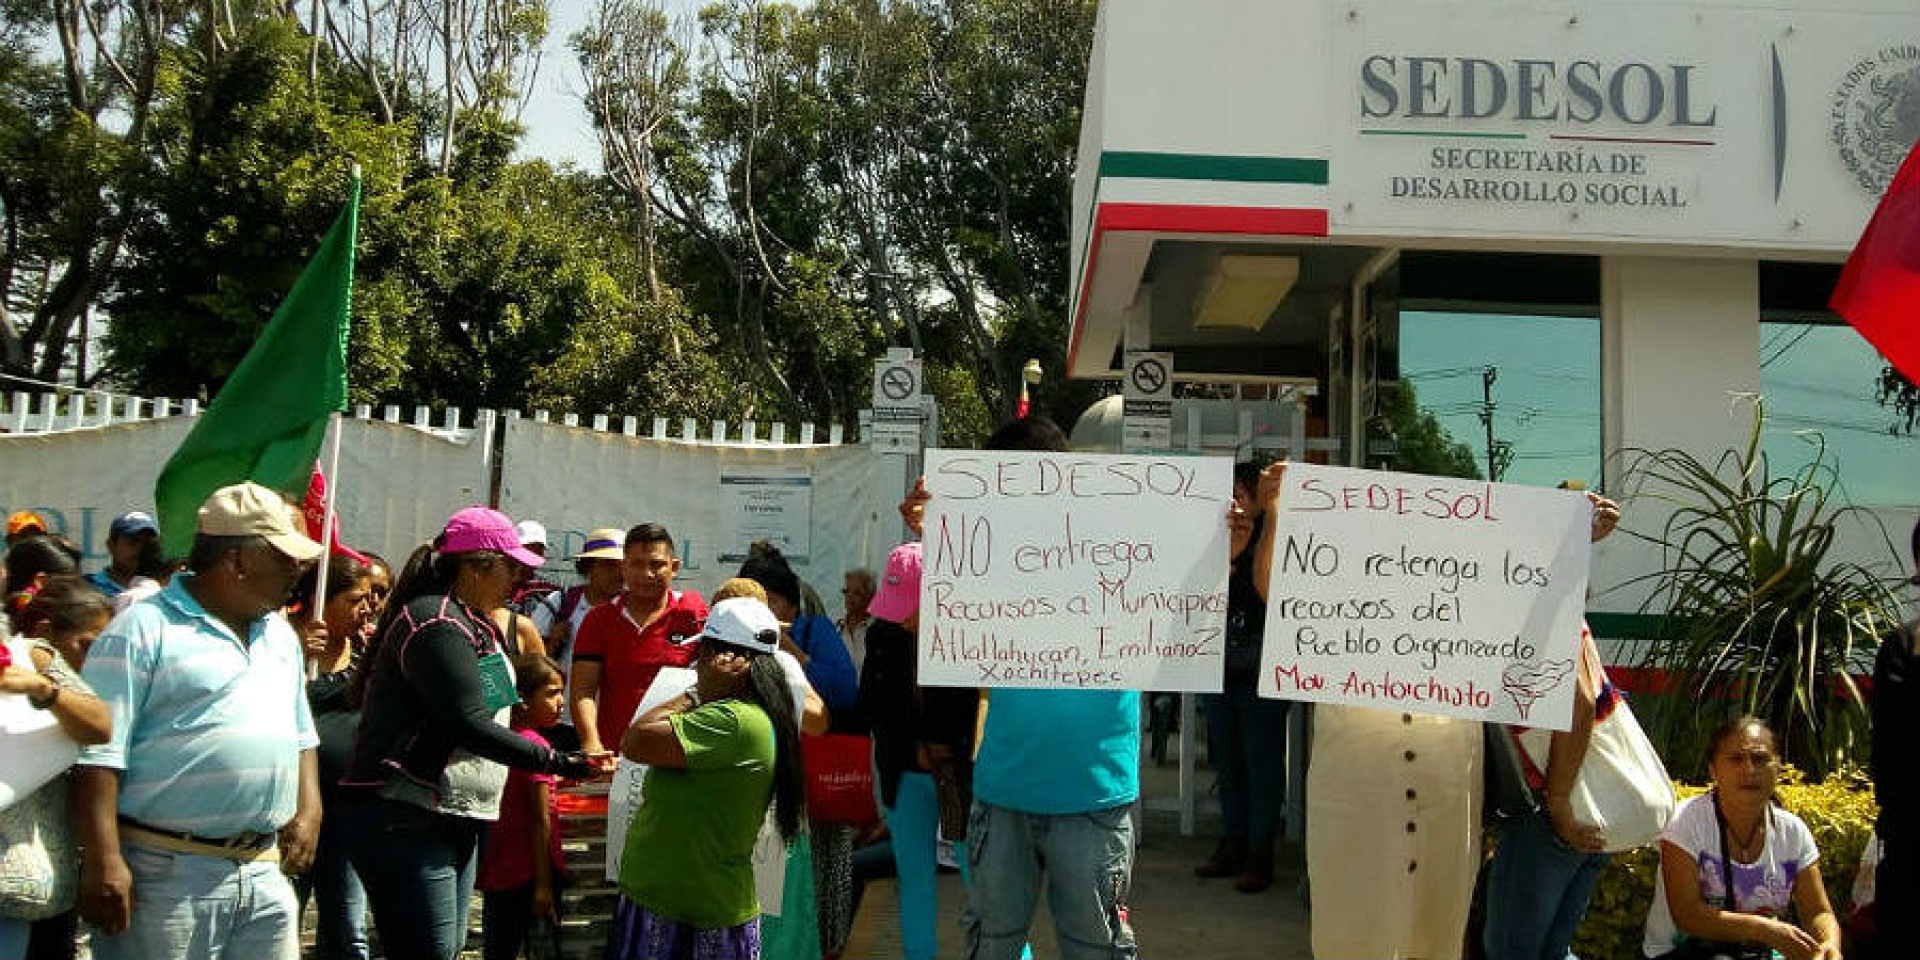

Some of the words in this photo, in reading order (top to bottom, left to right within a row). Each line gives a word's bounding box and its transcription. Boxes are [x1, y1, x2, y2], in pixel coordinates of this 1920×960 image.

[1360, 54, 1717, 128] SEDESOL
[1431, 146, 1603, 176] SECRETARÍA
[1609, 152, 1647, 176] DE
[1391, 176, 1578, 204] DESARROLLO
[1584, 182, 1687, 208] SOCIAL
[937, 458, 1224, 501] SEDESOL
[1289, 478, 1500, 521] SEDESOL
[933, 512, 992, 577] NO
[1014, 512, 1155, 583] entrega
[1282, 532, 1339, 577] NO
[1364, 545, 1480, 593] retenga
[1503, 549, 1551, 588] los
[927, 581, 1057, 621] Recursos
[1065, 593, 1091, 616] a
[1280, 597, 1396, 621] recursos
[1411, 592, 1462, 622] del
[1296, 625, 1381, 656] Pueblo
[1392, 633, 1536, 671] Organizado
[978, 661, 1123, 688] Xochitepec
